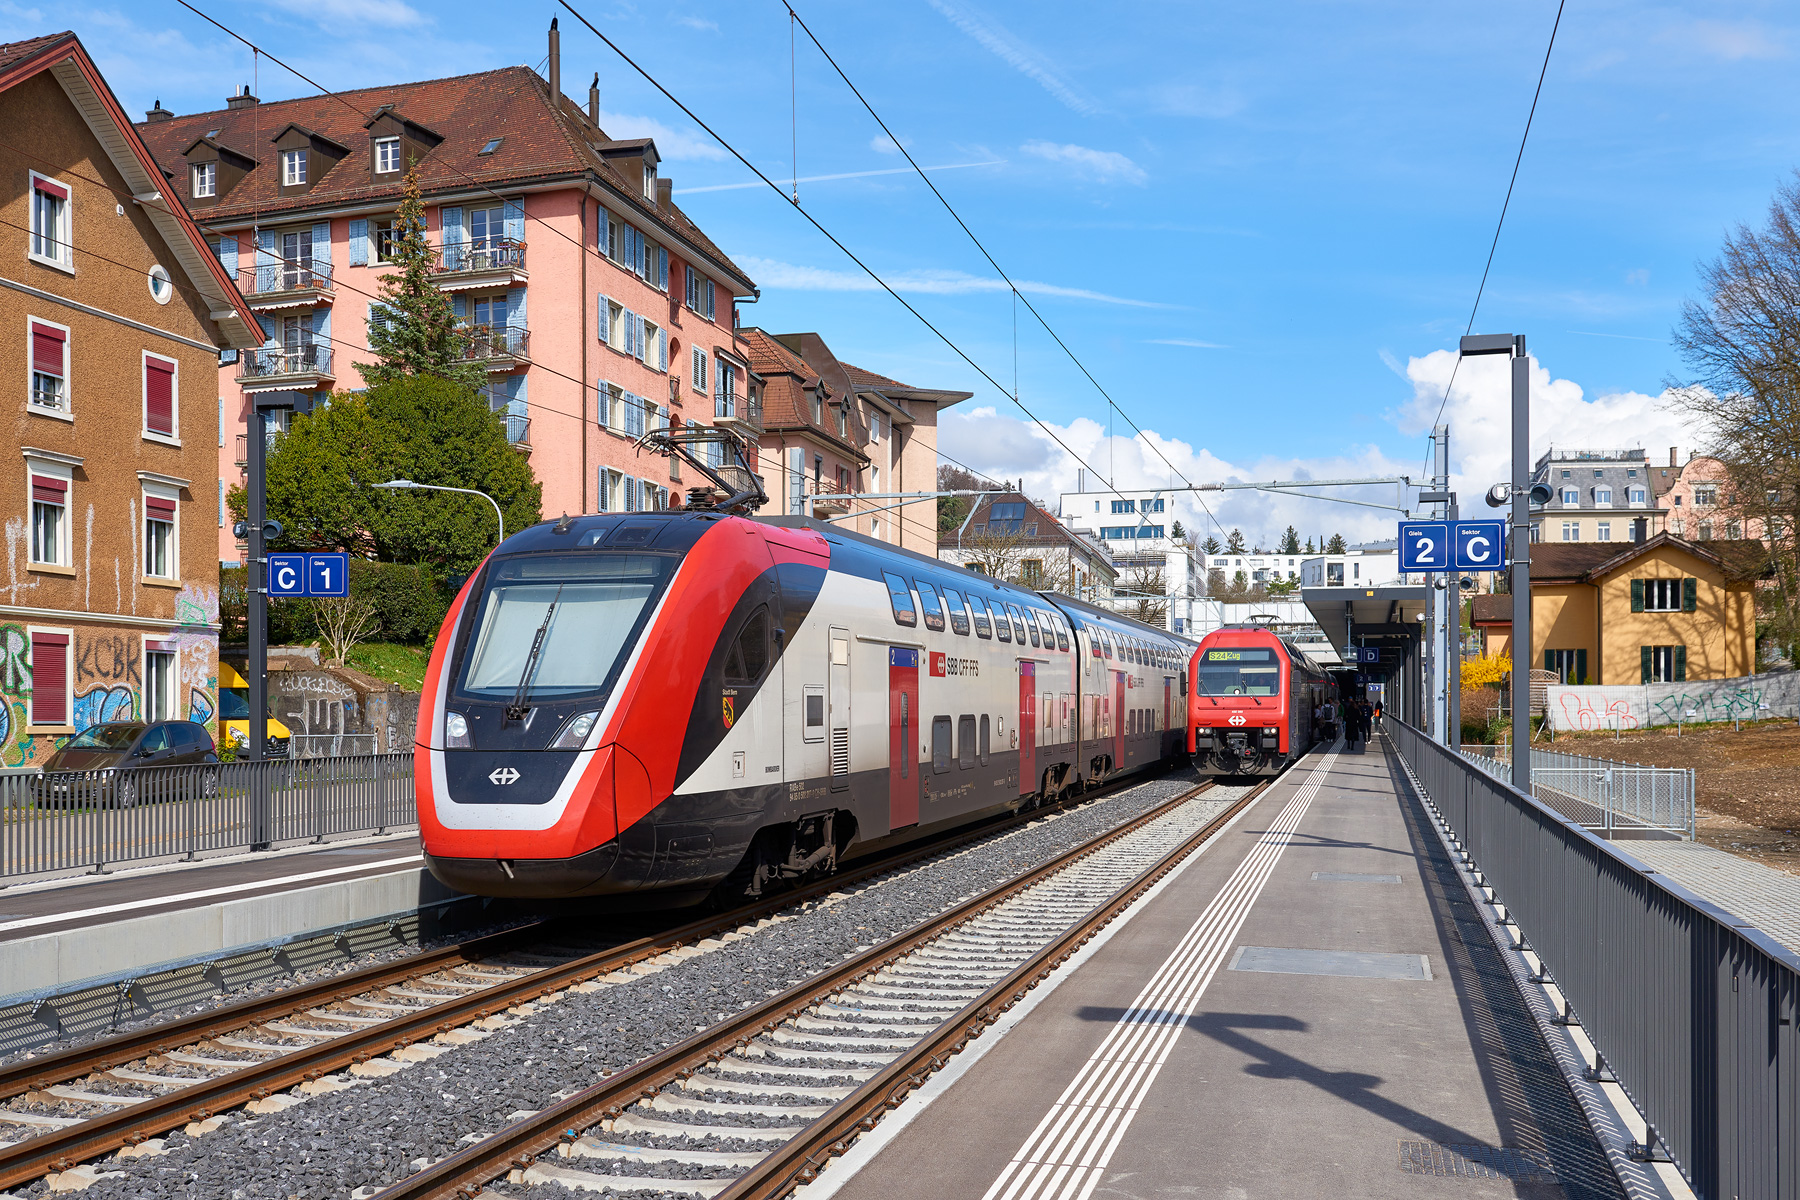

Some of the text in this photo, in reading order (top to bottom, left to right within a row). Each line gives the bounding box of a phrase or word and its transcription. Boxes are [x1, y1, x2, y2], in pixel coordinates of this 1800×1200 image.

[1415, 537, 1435, 563] 2
[1466, 536, 1490, 562] C
[277, 567, 296, 590] C
[320, 567, 330, 589] 1
[891, 649, 896, 665] 2
[1209, 652, 1241, 661] S24 Zug
[1368, 652, 1375, 660] D
[947, 657, 979, 677] SBB CFF FFS
